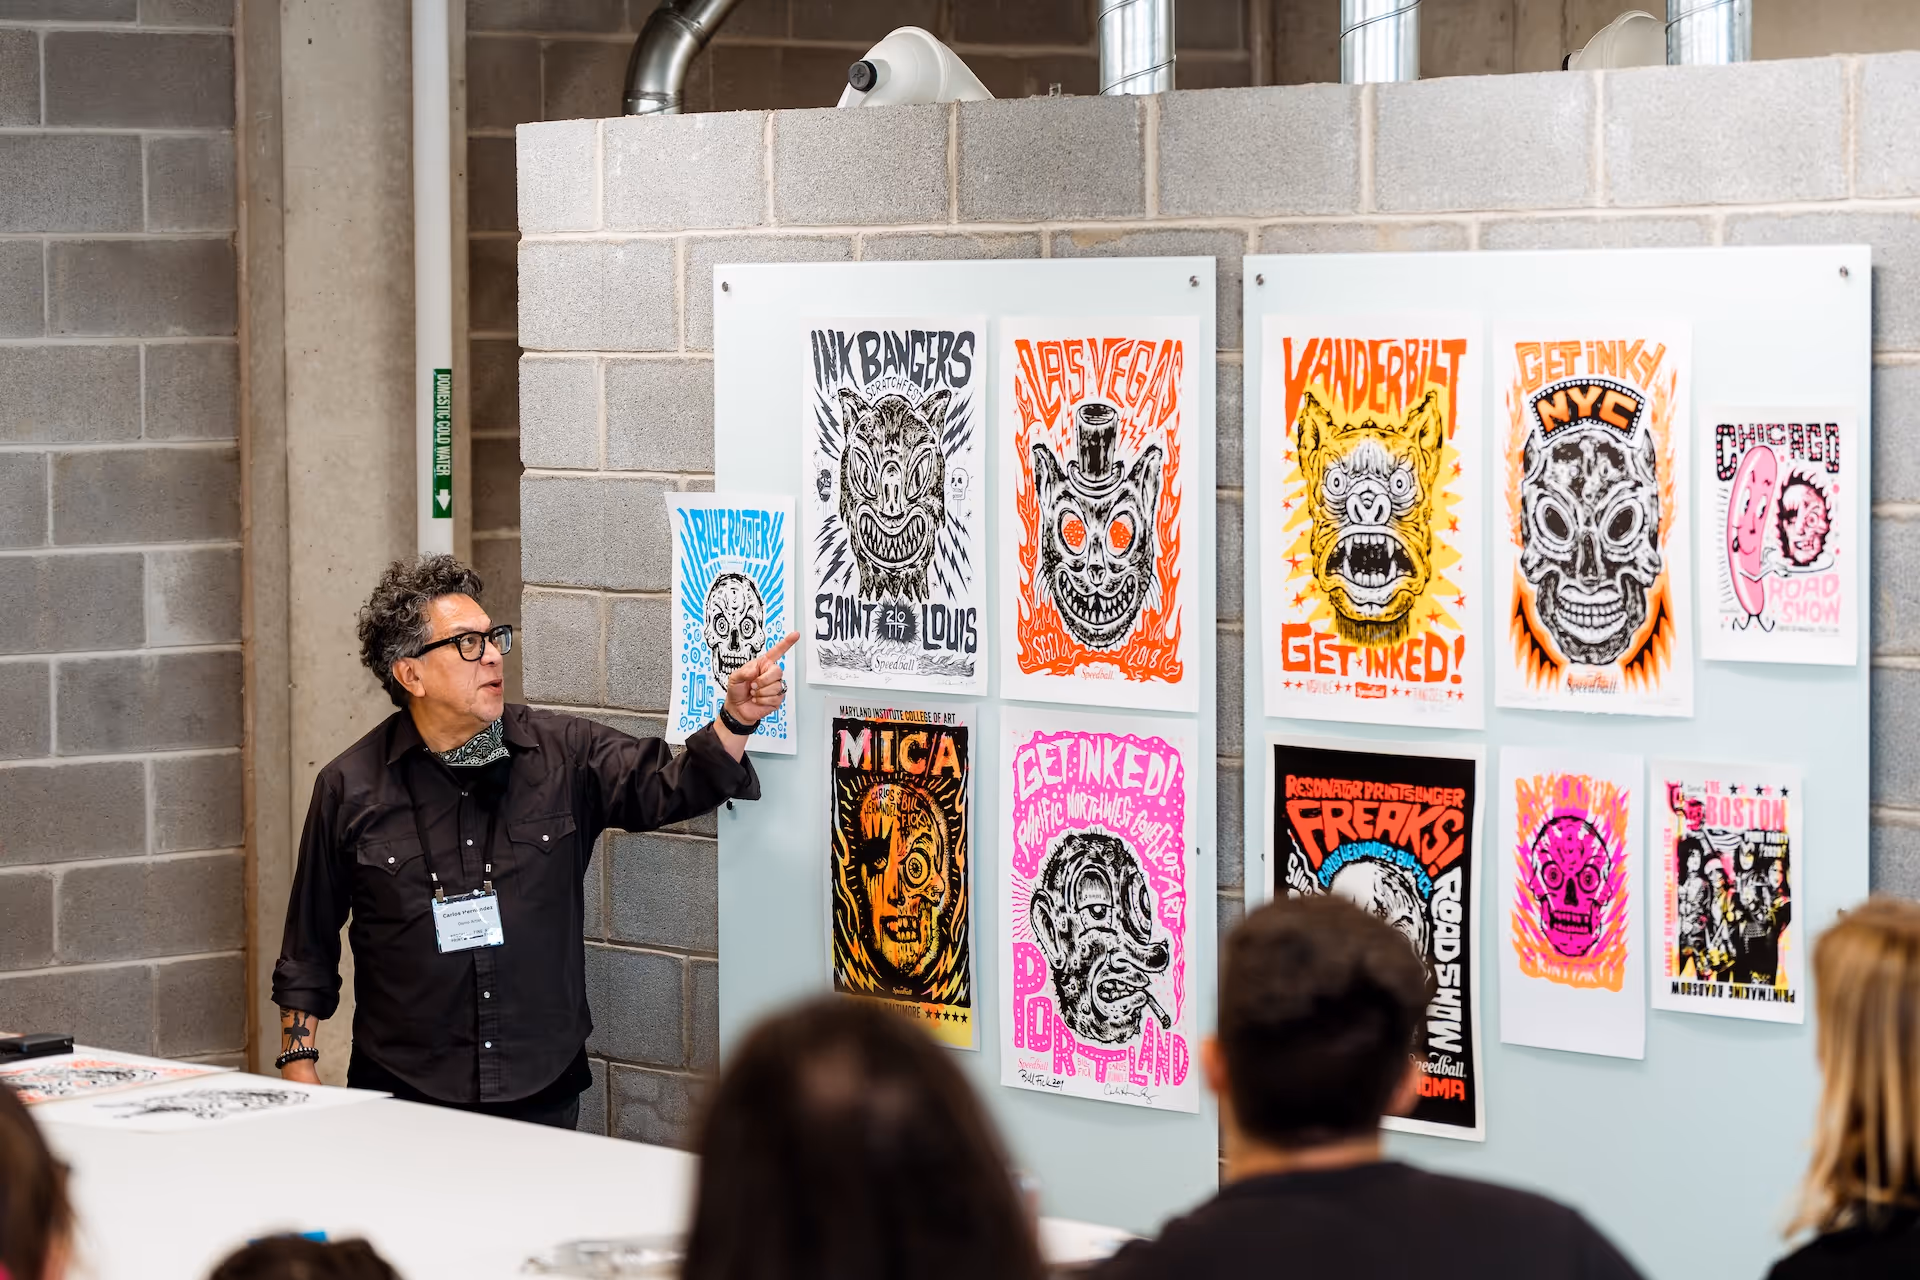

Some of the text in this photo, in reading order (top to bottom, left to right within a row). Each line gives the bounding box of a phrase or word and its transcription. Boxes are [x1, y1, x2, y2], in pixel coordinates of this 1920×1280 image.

[811, 329, 976, 394] INK BANGERS
[1087, 338, 1183, 430] VEGAS
[1515, 340, 1582, 394] GET
[865, 376, 924, 404] SCRATCHFEST
[1537, 385, 1638, 433] NYC
[437, 374, 450, 476] DOMESTIC COLD WATER
[1715, 423, 1840, 481] CHICAGO
[690, 508, 770, 564] BLUE ROOSTER
[1768, 574, 1840, 605] ROAD
[1781, 594, 1841, 624] SHOW
[815, 592, 978, 654] SAINT LOUIS
[874, 654, 915, 671] Speedball
[1128, 644, 1161, 668] 2018
[1281, 622, 1465, 684] GET INKED!
[688, 671, 714, 719] LOS
[839, 705, 956, 724] MARYLAND INSTITUTE COLLEGE OF ART
[837, 727, 962, 779] MICA
[1017, 735, 1179, 806] GET INKED!
[871, 787, 895, 801] CARLOS
[901, 793, 921, 813] BILL
[1066, 785, 1134, 828] NORTHWEST
[1286, 774, 1364, 800] RESONATOR
[902, 810, 927, 828] FICK
[1017, 797, 1065, 862] PACIFIC
[1286, 799, 1465, 878] FREAKS!
[1705, 796, 1786, 833] BOSTON
[1162, 852, 1182, 879] OF
[442, 910, 461, 919] Carlos
[1158, 875, 1183, 927] ART
[1012, 942, 1189, 1086] PORTLAND
[1671, 981, 1795, 1004] PRINTMAKING ROADSHOW
